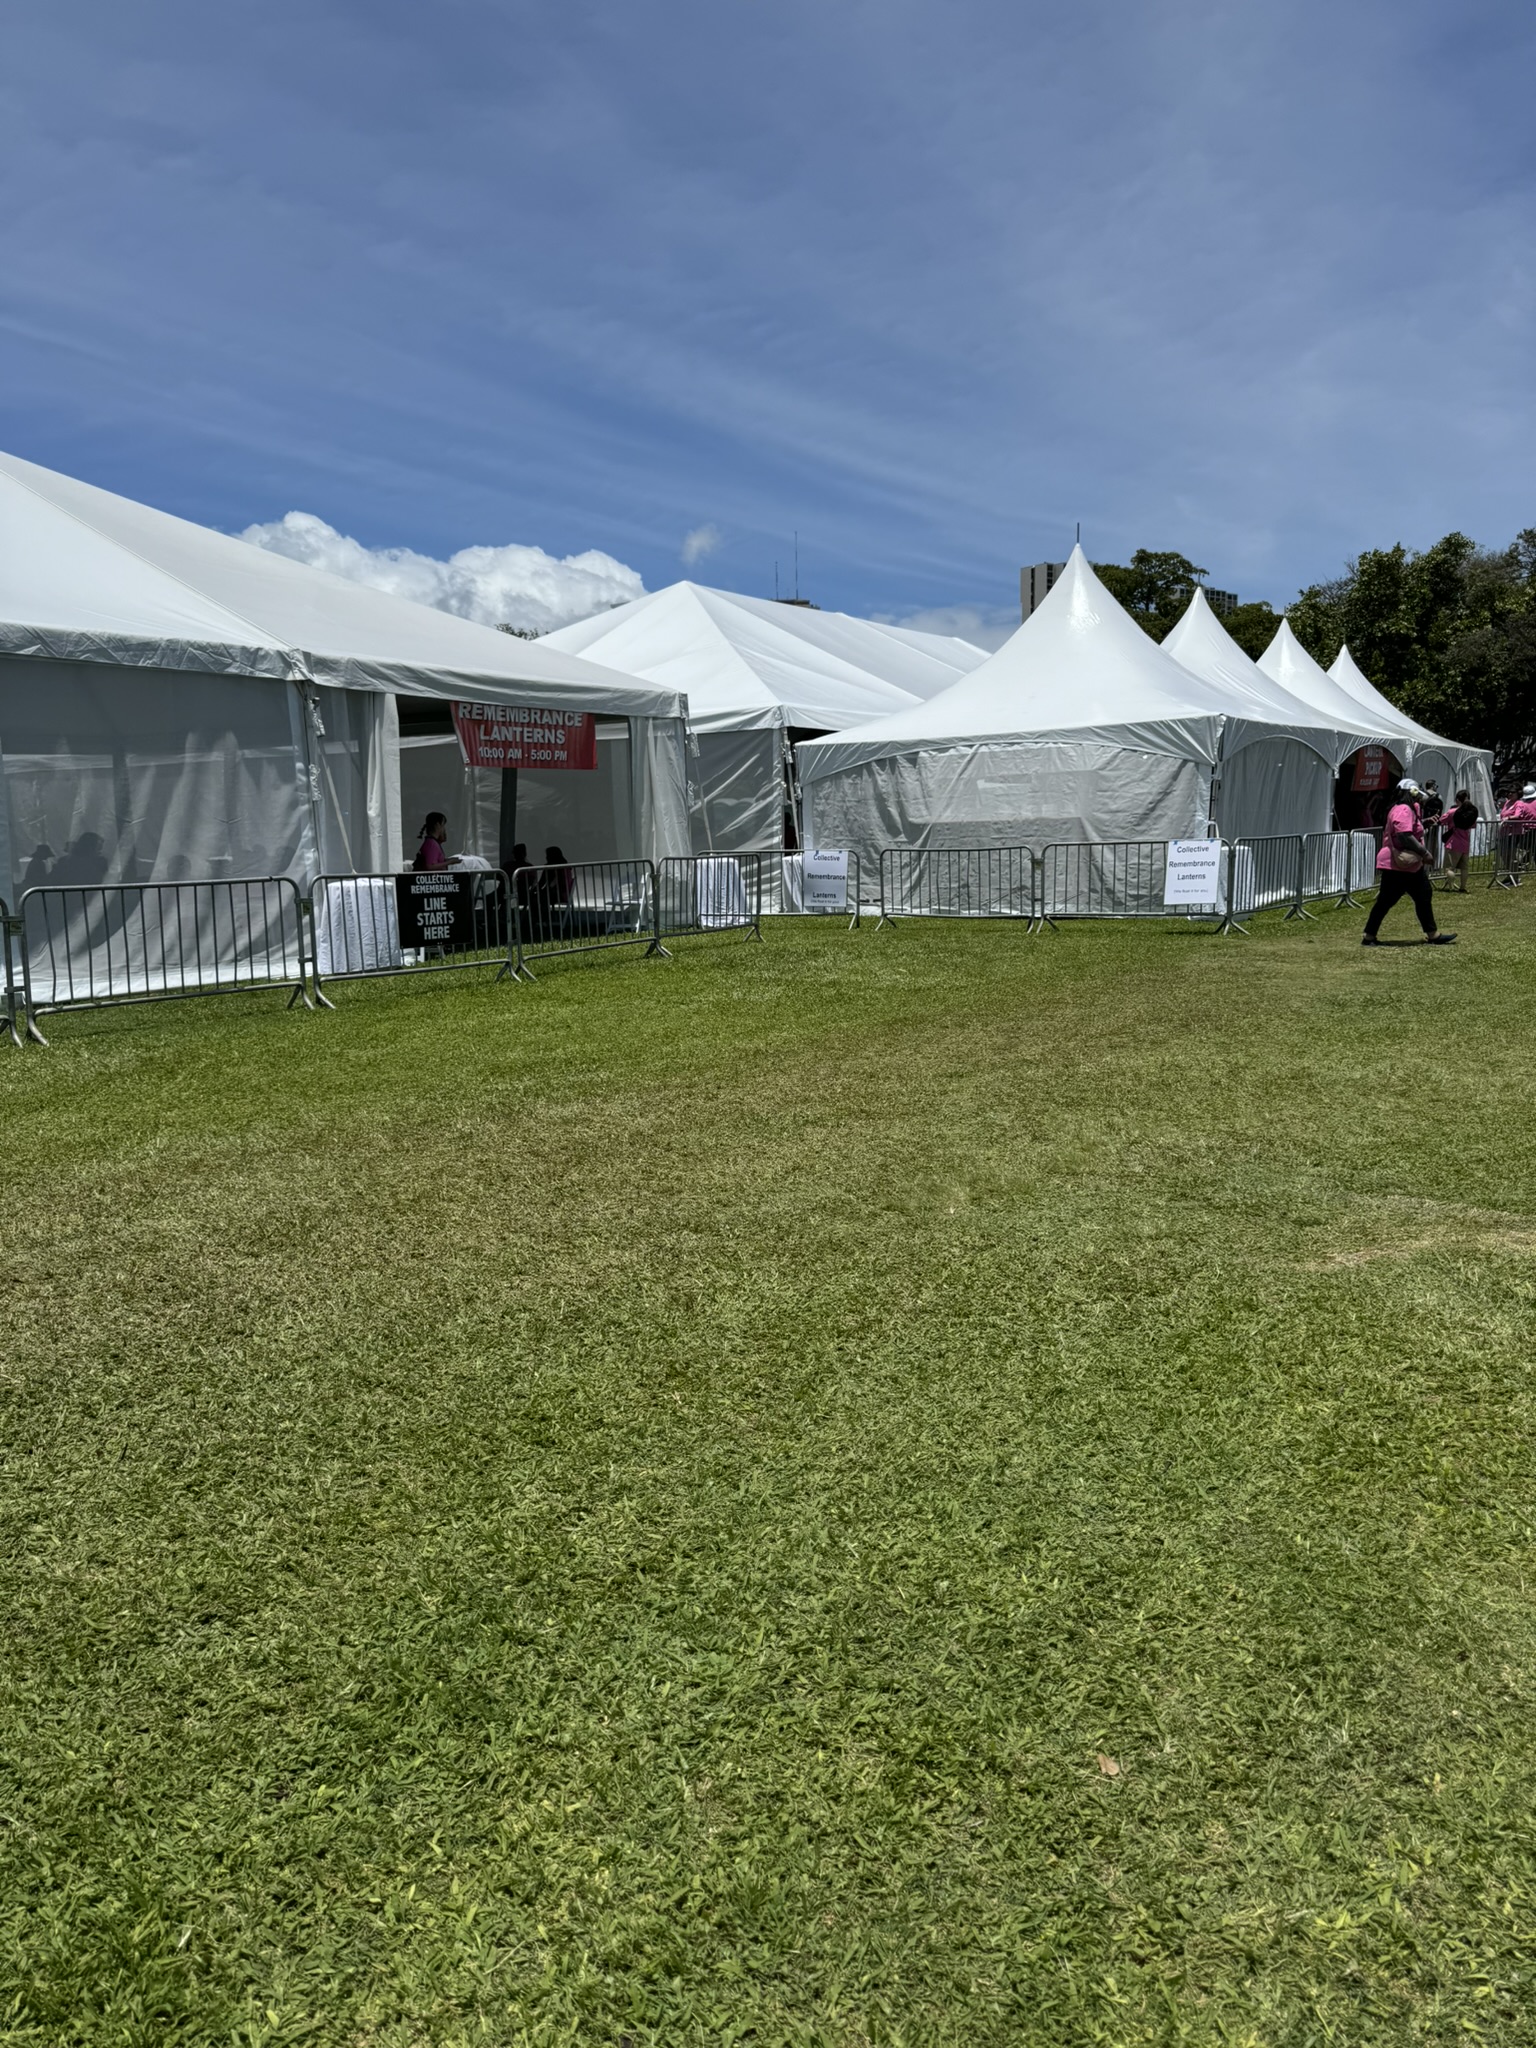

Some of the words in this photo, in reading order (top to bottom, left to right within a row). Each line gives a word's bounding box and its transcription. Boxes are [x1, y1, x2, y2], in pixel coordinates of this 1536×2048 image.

[458, 702, 583, 727] REMEMBRANCE
[479, 724, 566, 745] LANTERNS
[478, 746, 505, 760] 10:00
[507, 748, 523, 760] AM
[531, 749, 551, 761] 5:00
[554, 749, 568, 761] PM
[1176, 845, 1210, 853] Collective
[813, 854, 841, 862] Collective
[1168, 860, 1216, 868] Remembrance
[415, 874, 455, 885] COLLECTIVE
[807, 872, 846, 881] Remembrance
[1177, 873, 1206, 881] Lanterns
[410, 883, 460, 895] REMEMBRANCE
[812, 891, 837, 899] Lanterns
[423, 897, 447, 911] LINE
[416, 911, 455, 926] STARTS
[423, 926, 450, 940] HERE
